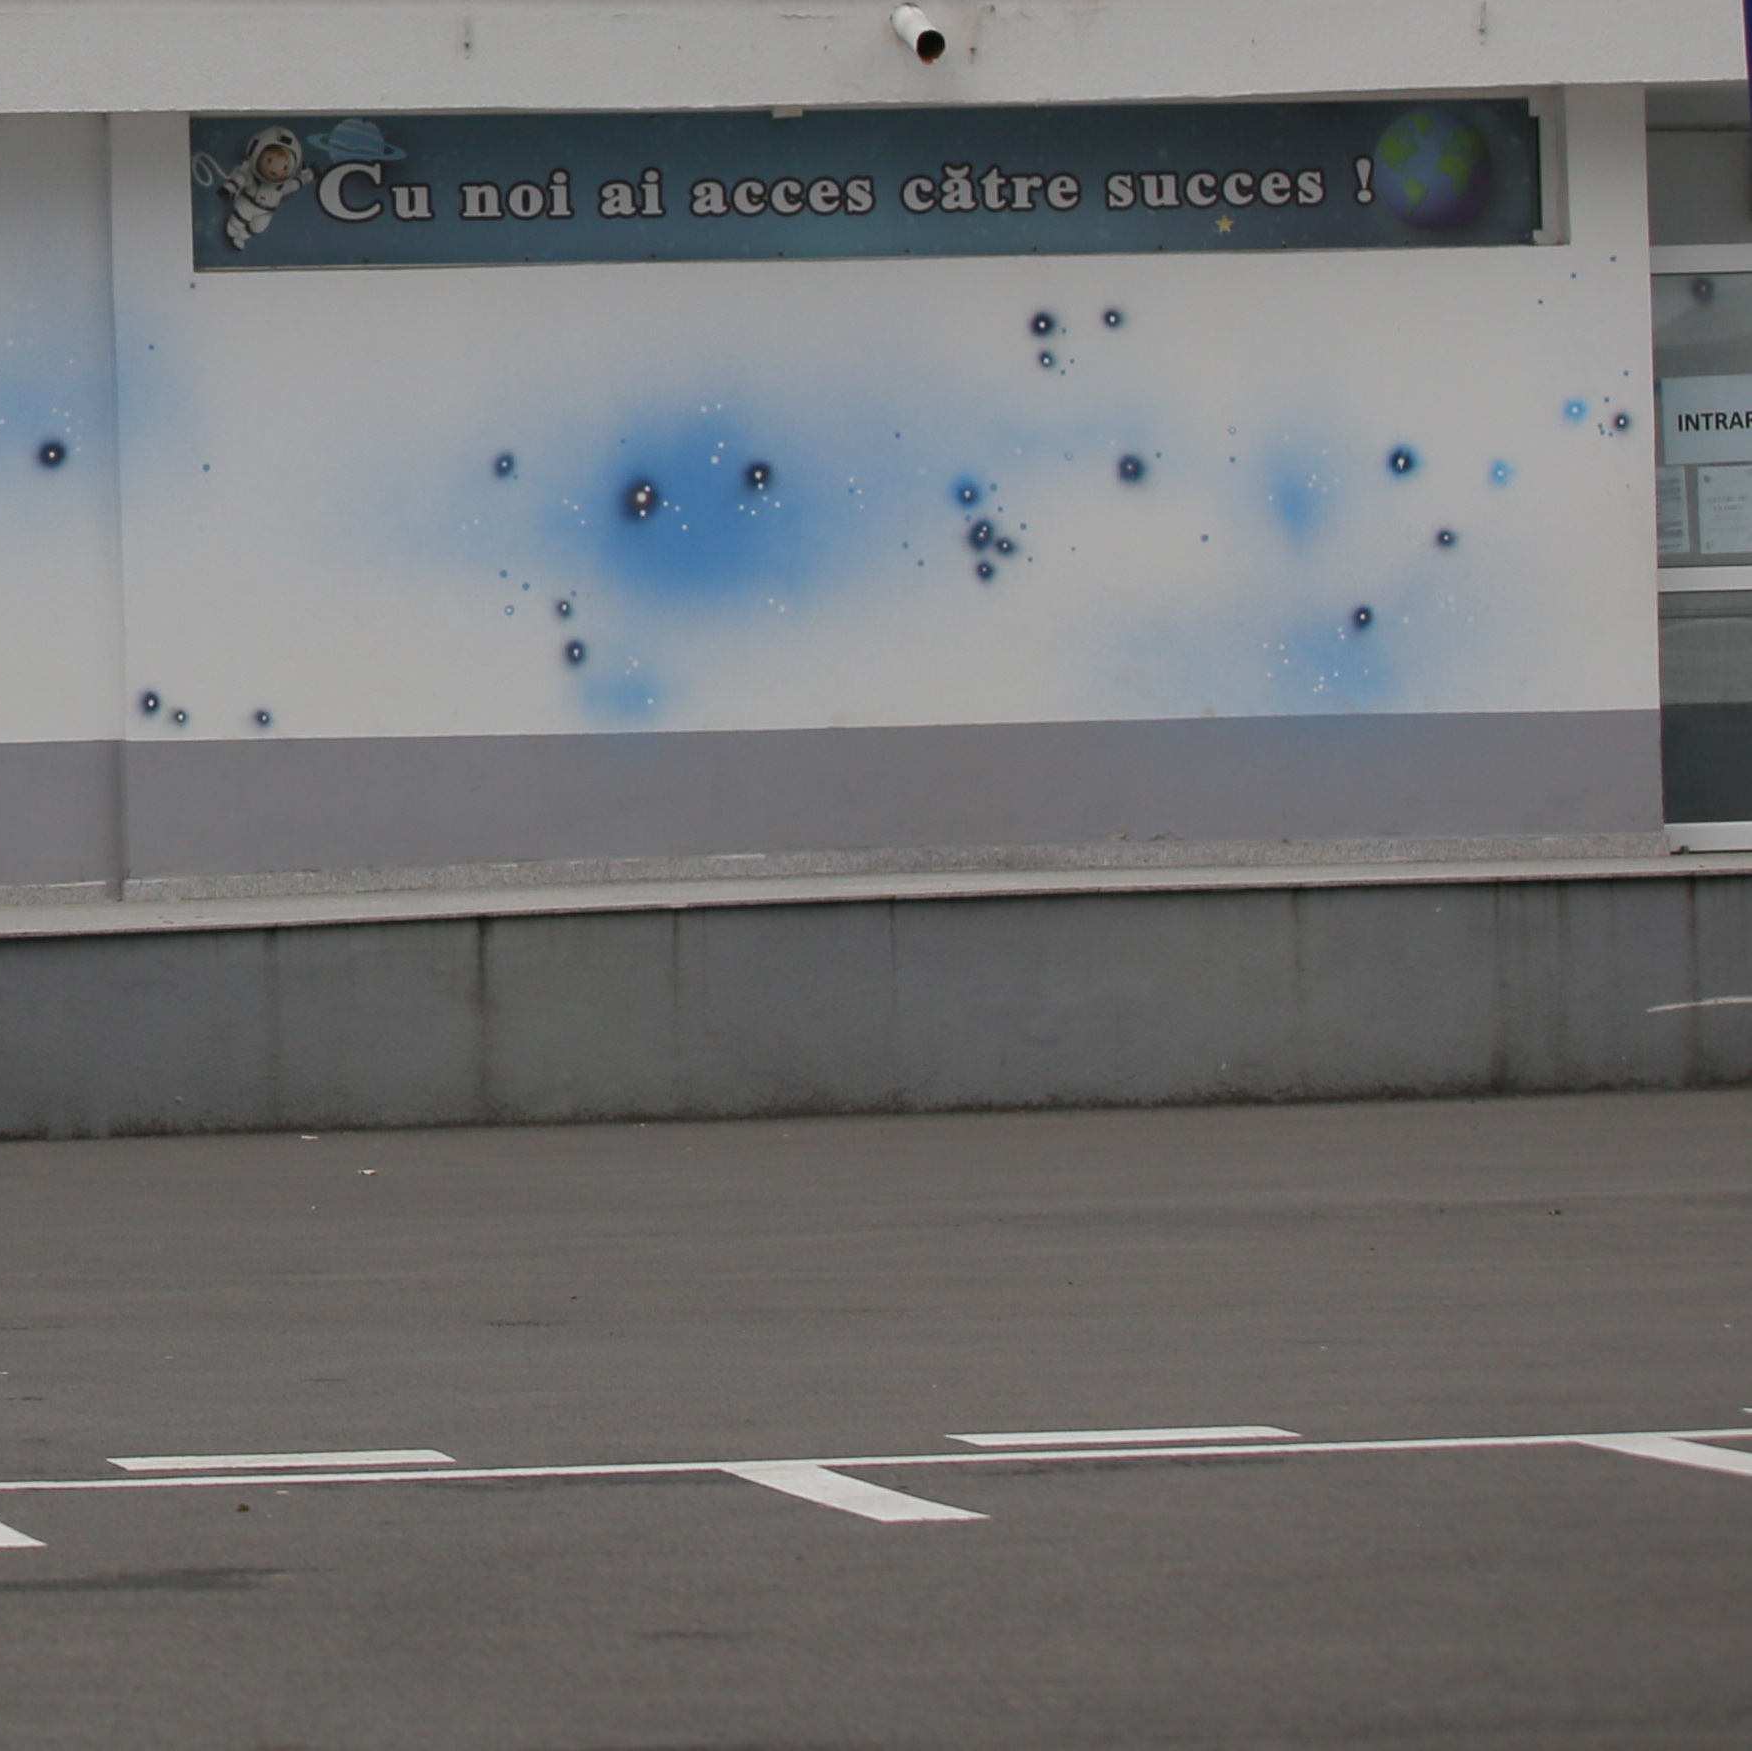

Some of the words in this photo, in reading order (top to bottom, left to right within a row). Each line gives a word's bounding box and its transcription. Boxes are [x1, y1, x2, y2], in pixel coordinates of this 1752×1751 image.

[318, 161, 433, 221] Cu
[461, 170, 573, 219] noi
[599, 169, 664, 217] ai
[692, 175, 874, 215] acces
[901, 165, 1081, 210] către
[1107, 169, 1325, 209] succes
[1354, 158, 1374, 204] !
